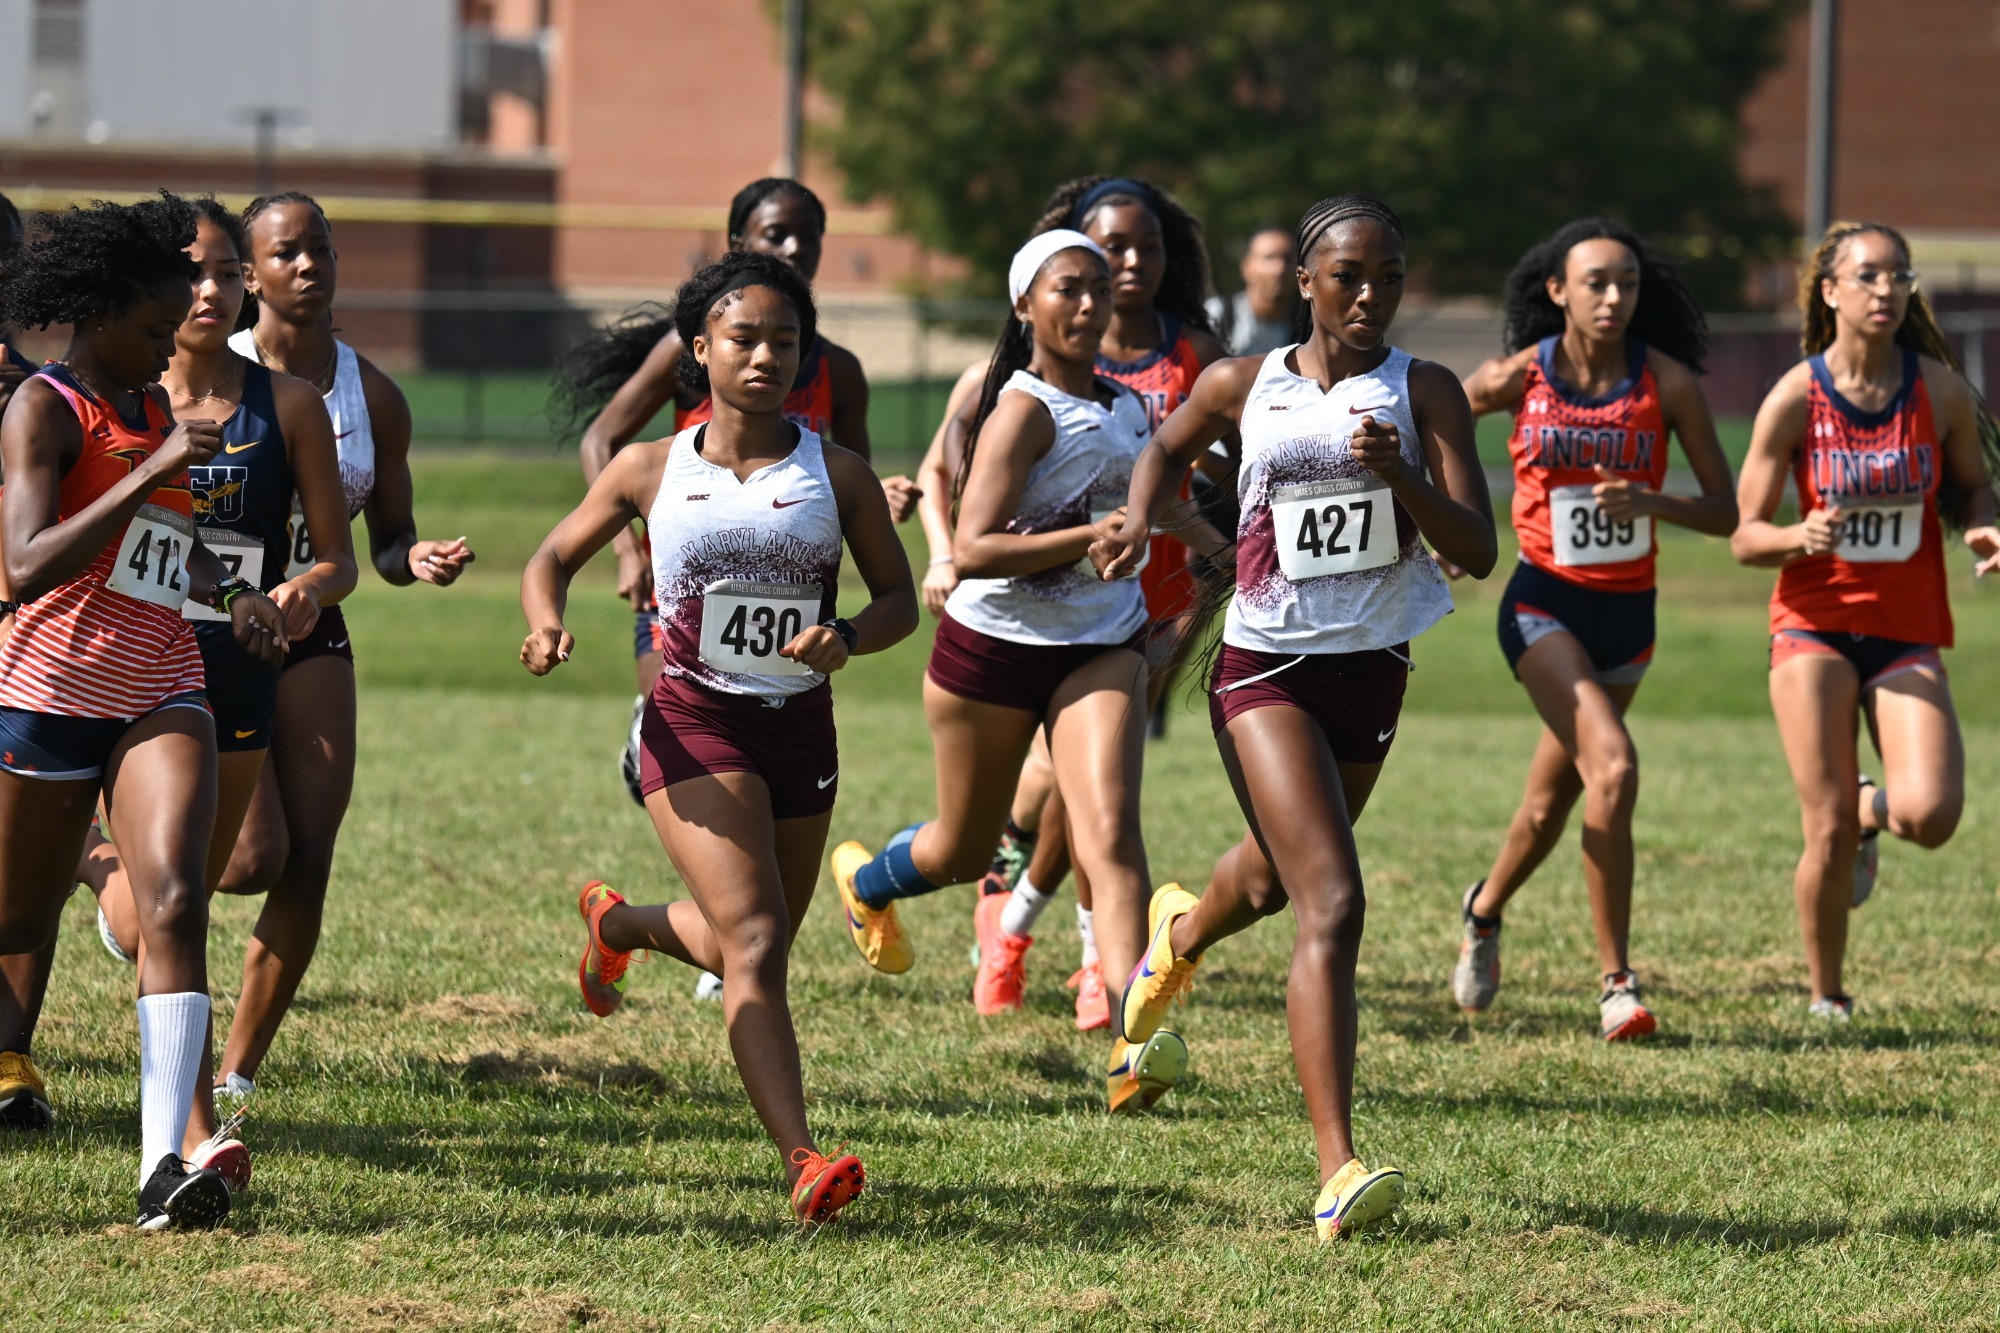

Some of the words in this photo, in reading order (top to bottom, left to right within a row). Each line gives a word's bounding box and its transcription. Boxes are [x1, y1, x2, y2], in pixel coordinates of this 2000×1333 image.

[1258, 434, 1354, 474] MARYLA
[1523, 426, 1656, 471] LINCOLN
[1294, 485, 1313, 498] UMES
[1313, 483, 1337, 496] CROSS
[1336, 480, 1366, 494] COUNTRY
[1811, 444, 1935, 496] LINCOLN
[158, 510, 173, 523] CROSS
[1297, 500, 1373, 558] 427
[1570, 507, 1636, 550] 399
[1843, 509, 1903, 549] 401
[199, 531, 212, 541] OSS
[211, 532, 242, 543] COUNTRY
[680, 527, 811, 567] MARYLAND
[128, 529, 182, 592] 412
[750, 585, 771, 596] CROSS
[772, 586, 801, 597] COUNTRY
[720, 604, 802, 658] 430
